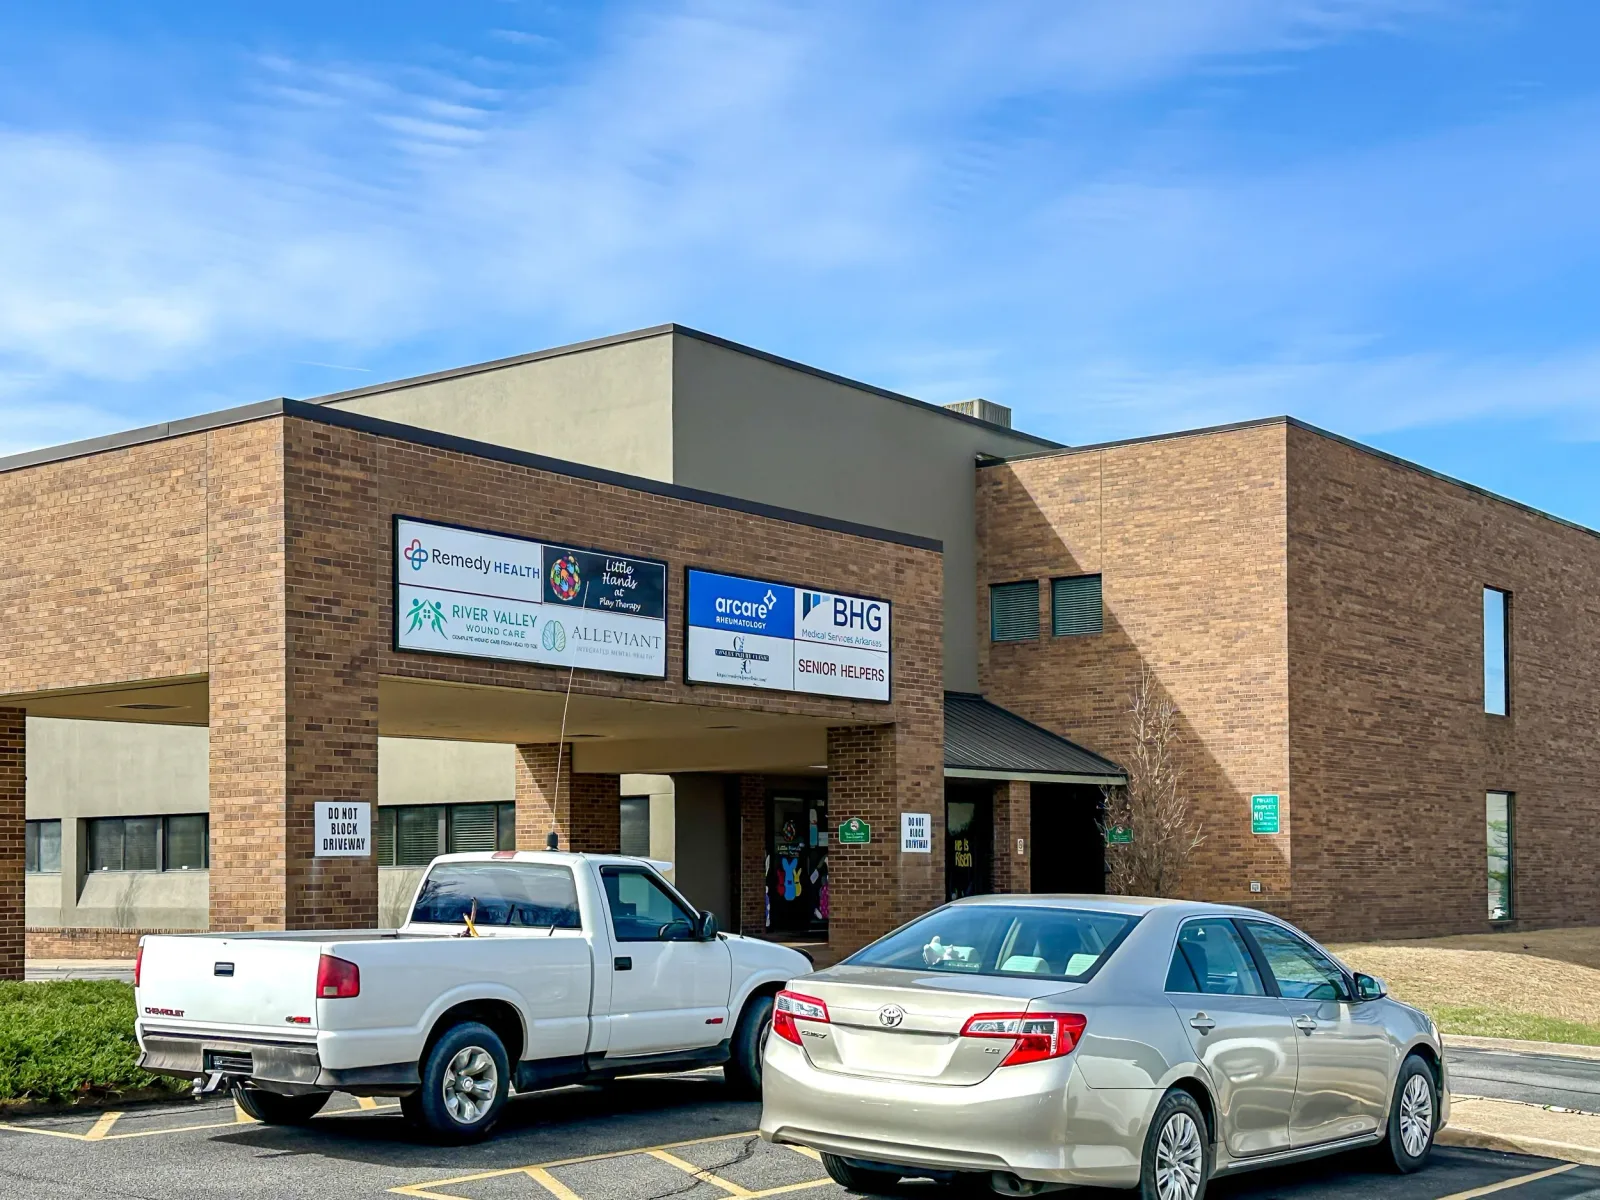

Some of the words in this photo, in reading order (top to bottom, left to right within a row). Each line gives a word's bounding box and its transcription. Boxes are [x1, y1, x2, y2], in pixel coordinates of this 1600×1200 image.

[432, 548, 491, 575] Remedy
[494, 561, 540, 579] HEALTH
[605, 559, 634, 574] Little
[602, 572, 638, 589] Hands
[614, 588, 625, 597] at
[599, 597, 615, 608] Play
[615, 599, 641, 612] Therapy
[715, 597, 768, 619] arcare
[452, 604, 488, 622] RIVER
[493, 610, 537, 628] VALLEY
[833, 597, 882, 632] BHG
[716, 615, 767, 630] RHEUMATOLOGY
[452, 634, 474, 642] COMPLETE
[466, 624, 499, 635] WOUND
[503, 628, 526, 639] CARE
[571, 626, 662, 649] ALLEVIANT
[801, 628, 827, 639] Medical
[828, 632, 853, 644] Services
[854, 636, 882, 648] Arkansas
[576, 645, 610, 655] INTEGRATED
[610, 649, 631, 657] MENTAL
[798, 658, 837, 677] SENIOR
[840, 664, 885, 682] HELPERS
[328, 807, 339, 820] DO
[342, 807, 358, 820] NOT
[908, 816, 914, 826] DO
[916, 817, 924, 826] NOT
[1253, 811, 1264, 821] NO
[331, 822, 358, 835] BLOCK
[910, 828, 924, 838] BLOCK
[323, 838, 366, 851] DRIVEWAY
[906, 839, 928, 848] DRIVEWAY
[144, 1006, 185, 1018] CHEVROLET
